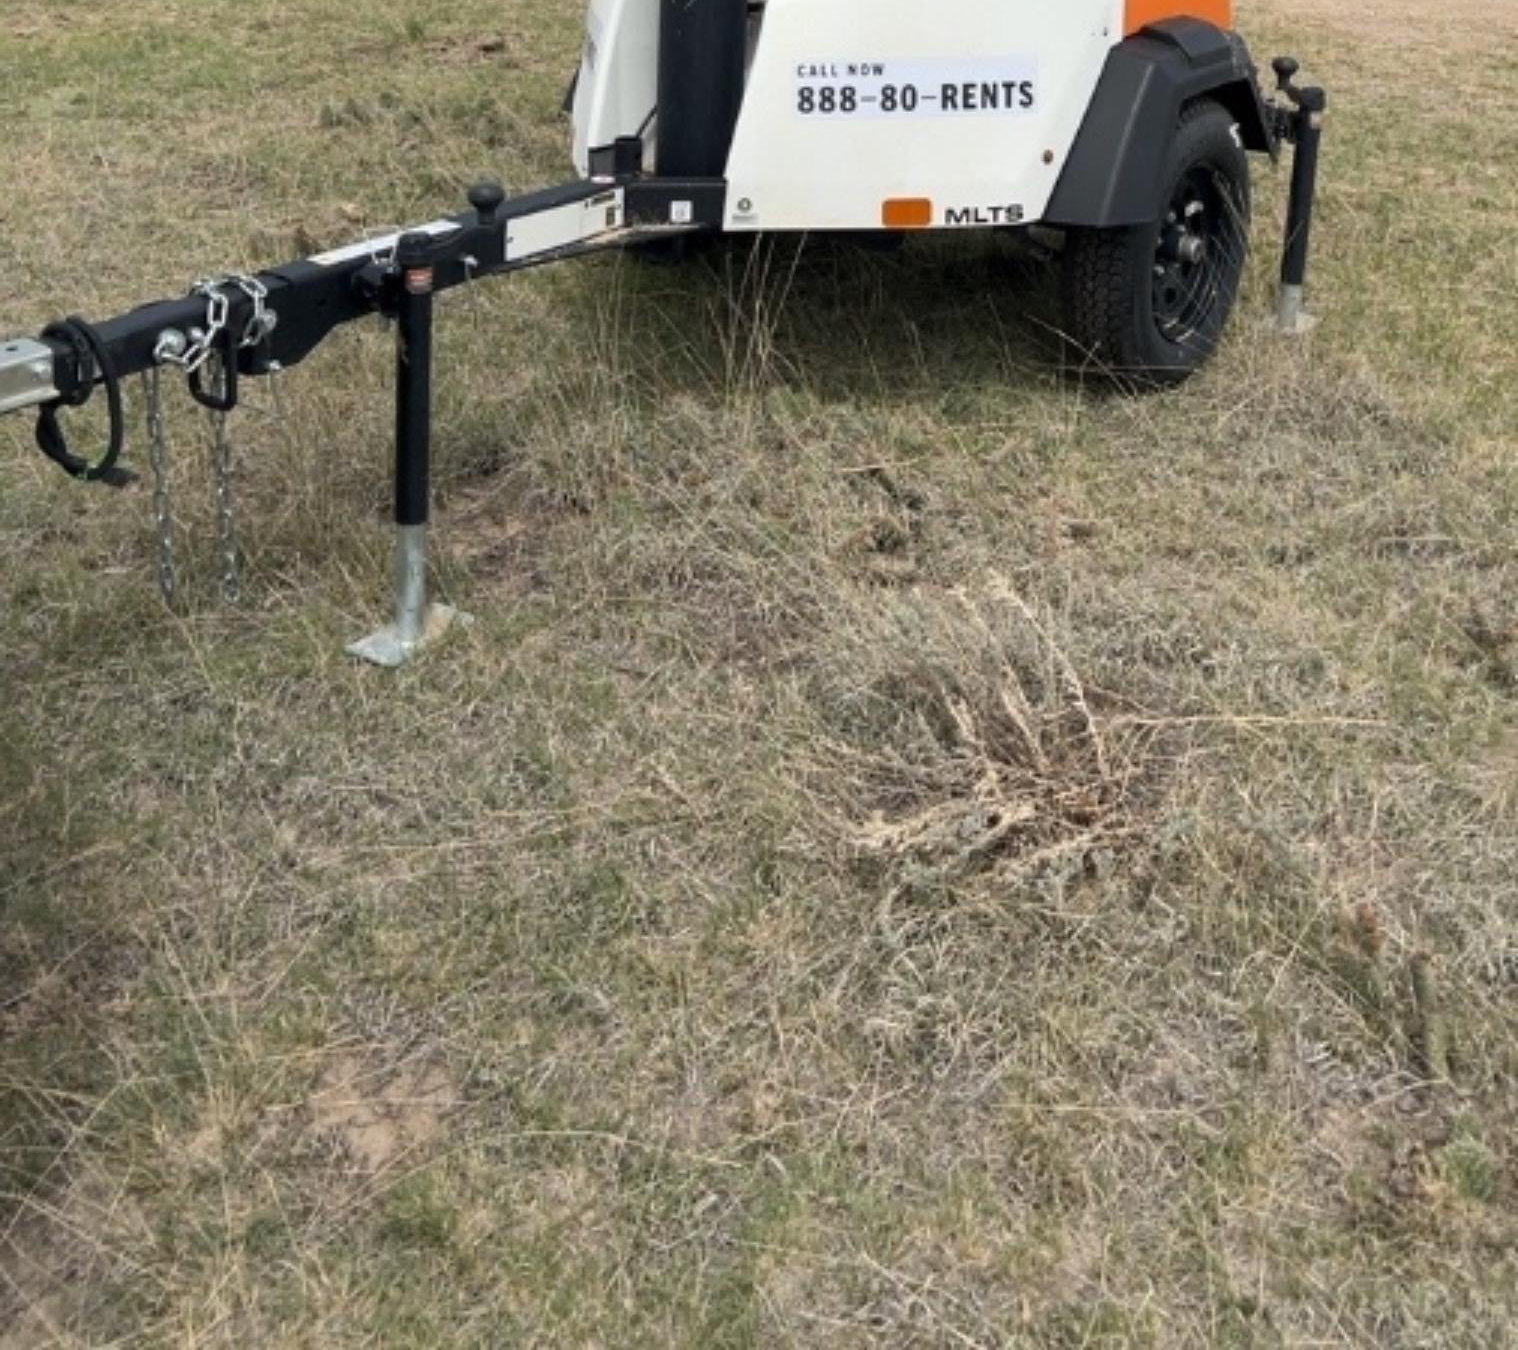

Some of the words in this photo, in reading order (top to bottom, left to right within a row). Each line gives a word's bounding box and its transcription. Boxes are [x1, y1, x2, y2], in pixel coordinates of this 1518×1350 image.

[797, 63, 838, 78] CALL
[846, 63, 885, 77] NOW
[797, 80, 1034, 114] 888-80-RENTS
